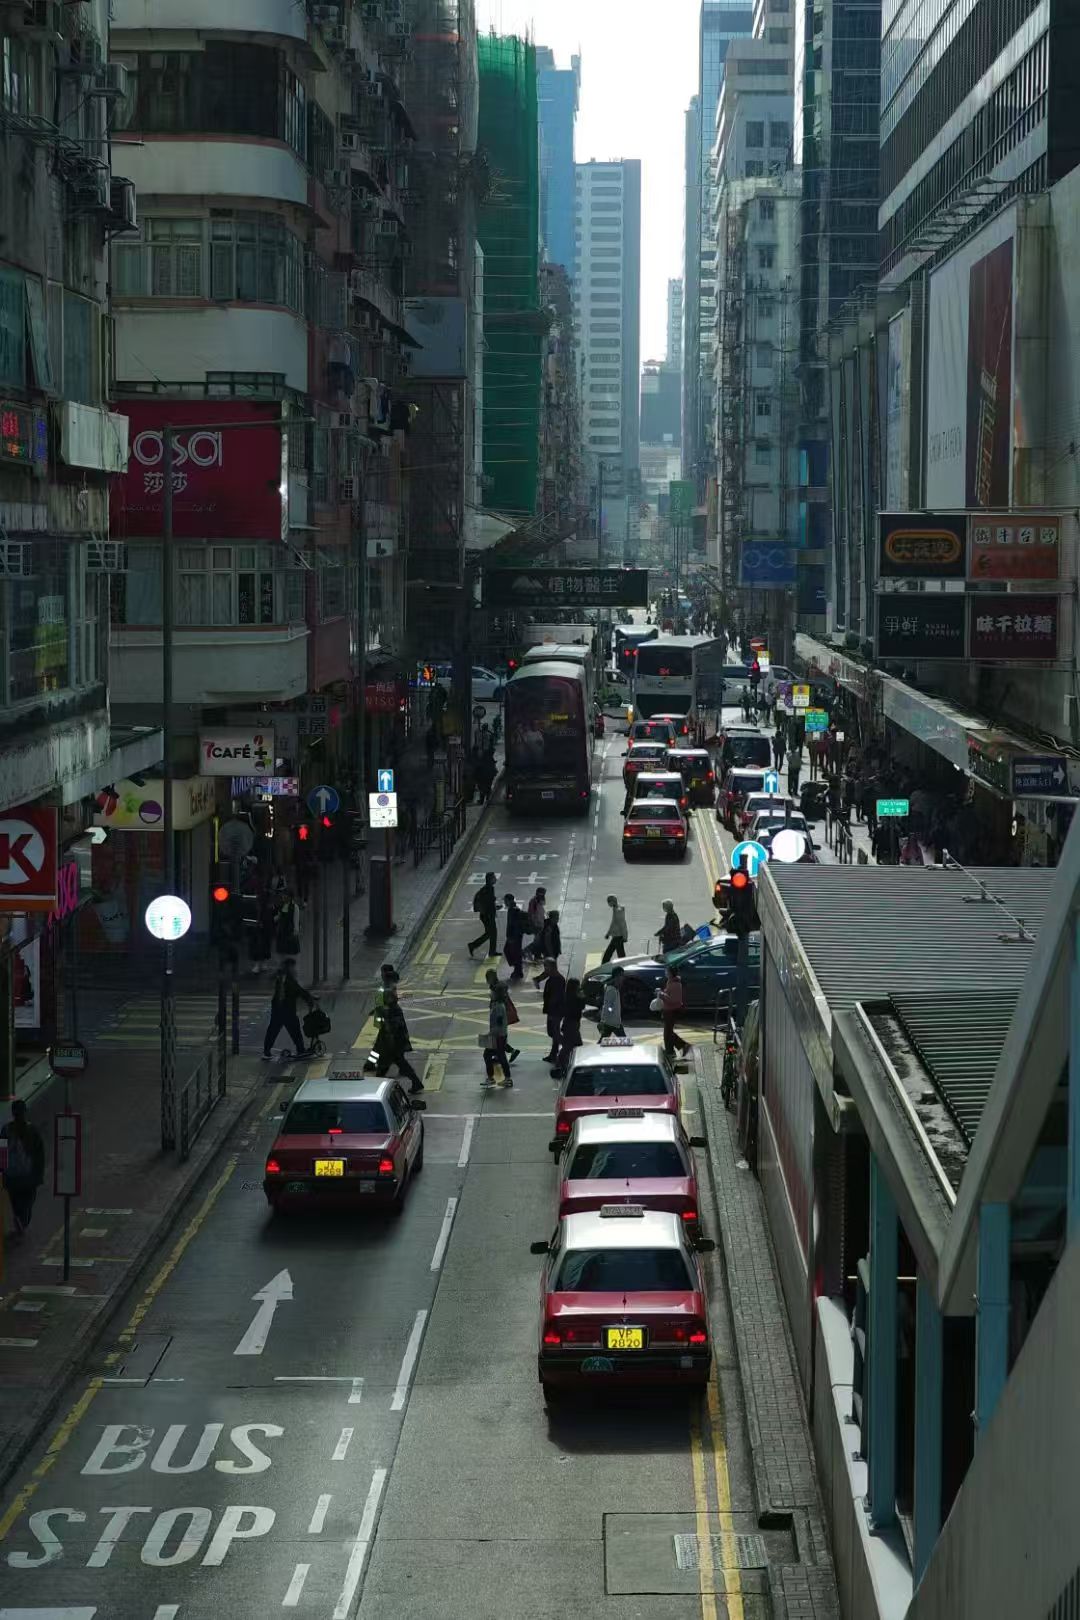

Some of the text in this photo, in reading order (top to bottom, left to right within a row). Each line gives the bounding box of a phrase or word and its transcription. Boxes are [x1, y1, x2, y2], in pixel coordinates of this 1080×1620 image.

[128, 430, 223, 466] asa
[549, 575, 619, 593] 植物醫生
[976, 614, 1053, 633] 味千拉麵
[0, 833, 38, 881] K
[610, 1339, 641, 1348] 2820
[618, 1329, 633, 1338] VP
[80, 1422, 285, 1475] BUS
[7, 1505, 276, 1569] STOP
